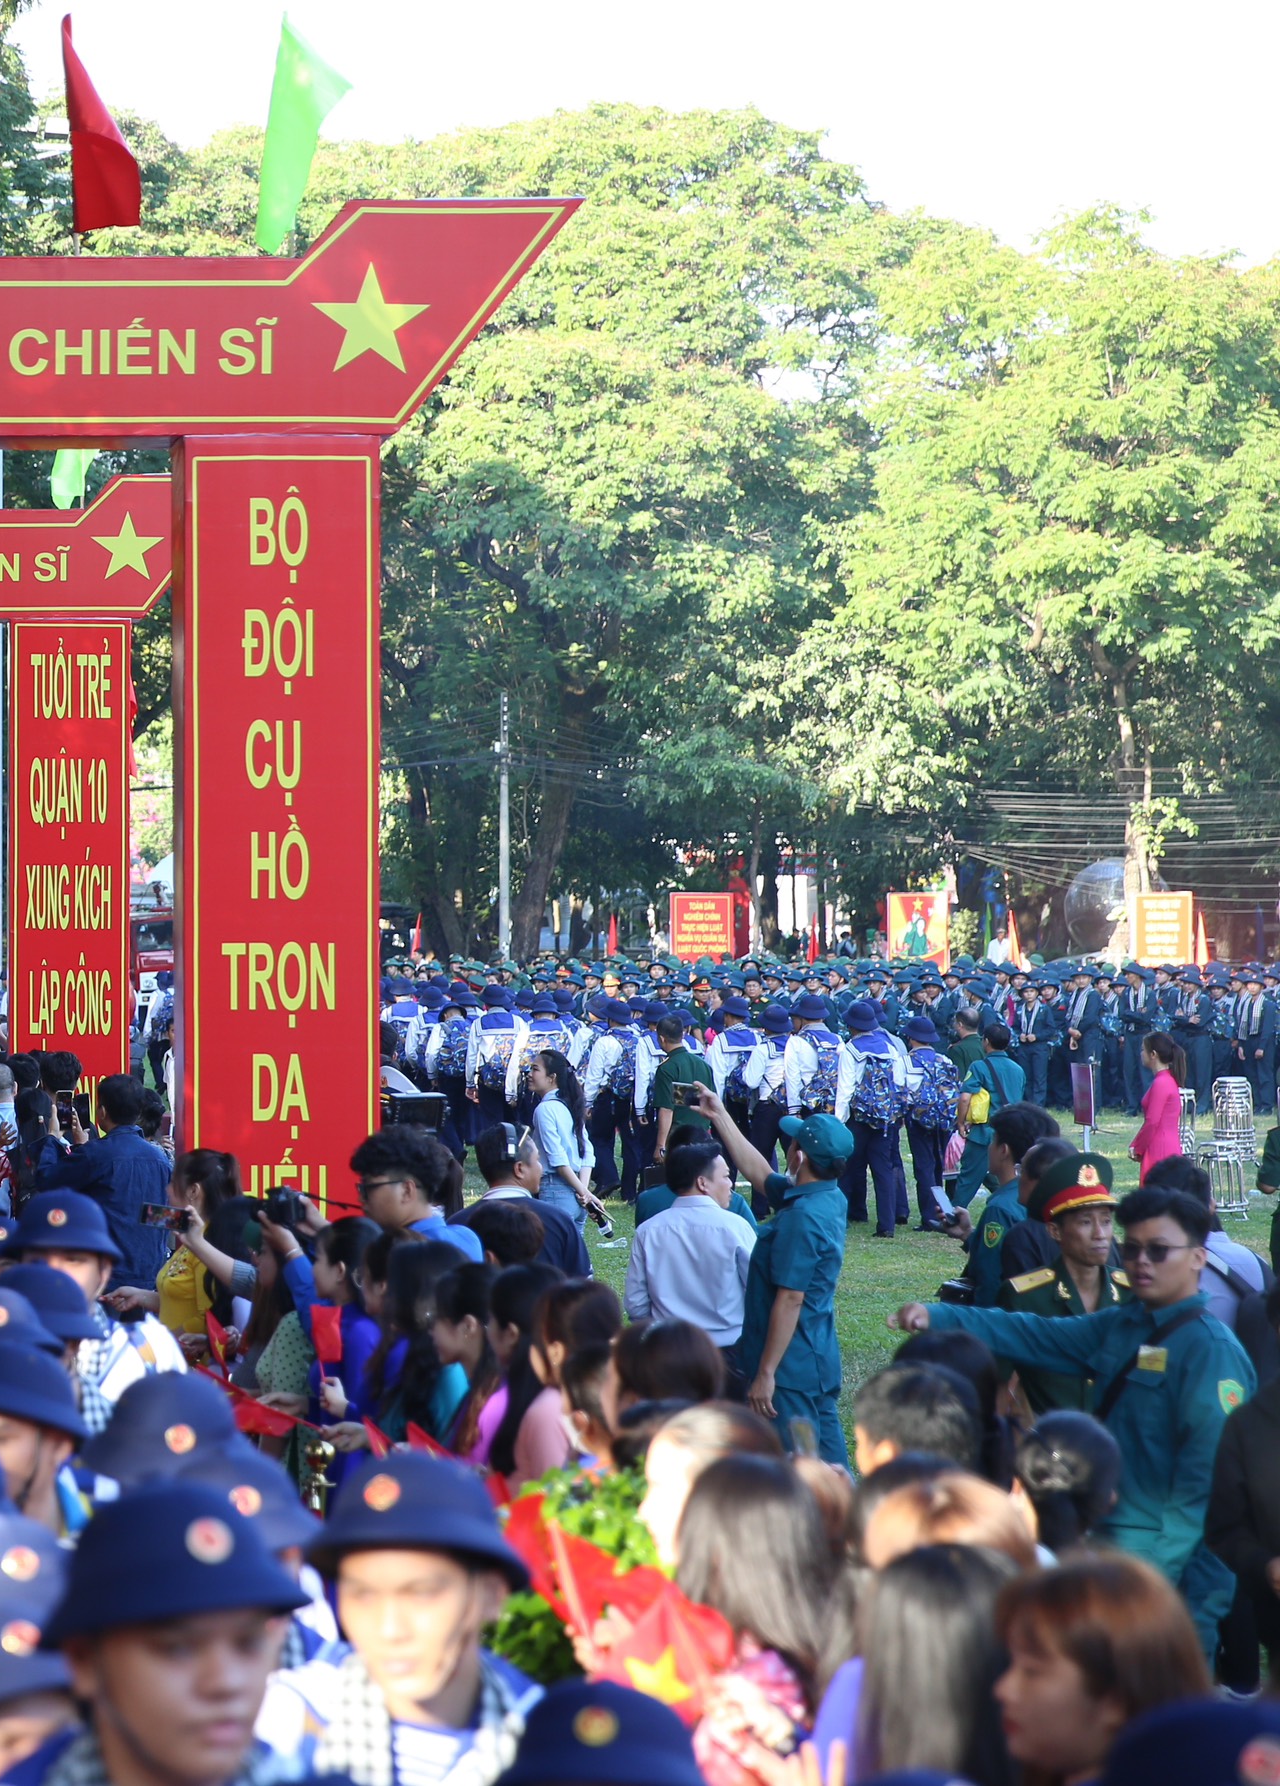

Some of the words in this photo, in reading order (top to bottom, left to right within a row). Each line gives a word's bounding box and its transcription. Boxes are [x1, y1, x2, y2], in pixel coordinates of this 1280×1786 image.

[9, 317, 198, 377] CHIẾN
[218, 317, 281, 376] SĨ
[34, 545, 71, 583] SĨ
[249, 486, 310, 584] BỘ
[30, 637, 72, 719] TUỔI
[76, 637, 112, 719] TRẺ
[241, 597, 315, 696] ĐỘI
[29, 747, 82, 840] QUẬN
[88, 758, 108, 824] 10
[245, 719, 302, 807] CỤ
[25, 864, 70, 931] XUNG
[74, 846, 112, 931] KÍCH
[250, 814, 310, 901] HỒ
[29, 959, 61, 1051] LẬP
[64, 952, 112, 1036] CÔNG
[222, 941, 336, 1029] TRỌN
[252, 1054, 311, 1140] DẠ
